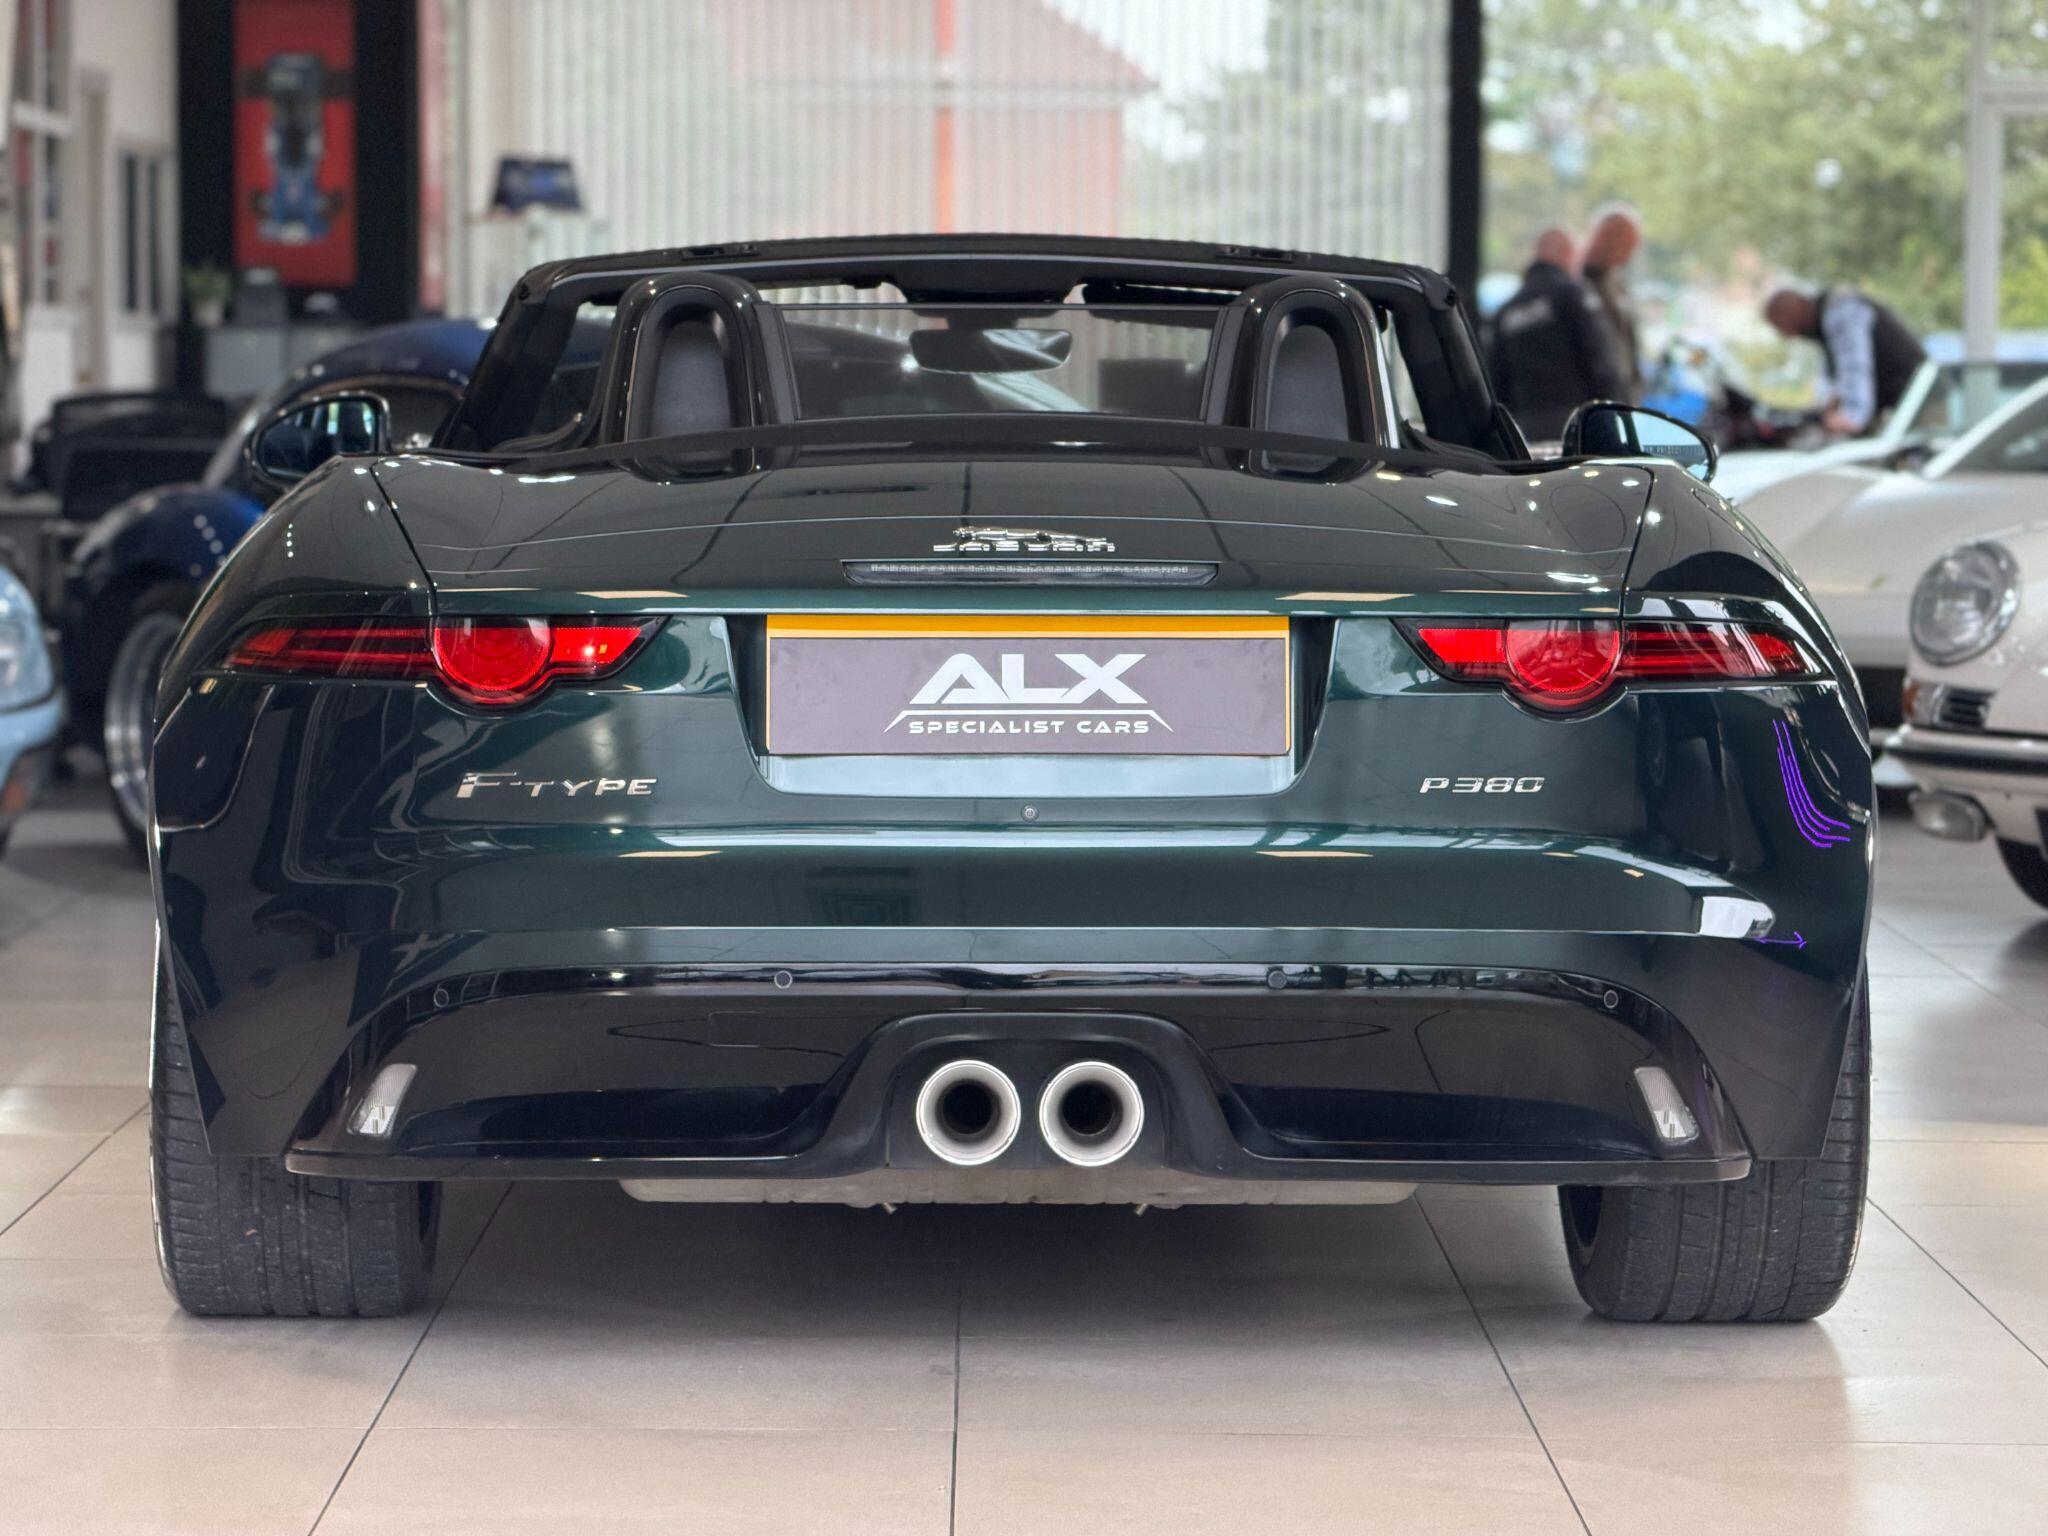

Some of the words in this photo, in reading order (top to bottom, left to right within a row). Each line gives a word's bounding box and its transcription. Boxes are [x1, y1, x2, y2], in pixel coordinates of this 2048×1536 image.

[909, 653, 1148, 704] ALX
[909, 720, 1065, 734] SPECIALIST
[1076, 720, 1150, 734] CARS
[456, 772, 657, 798] F-TYPE
[1419, 776, 1546, 794] P380
